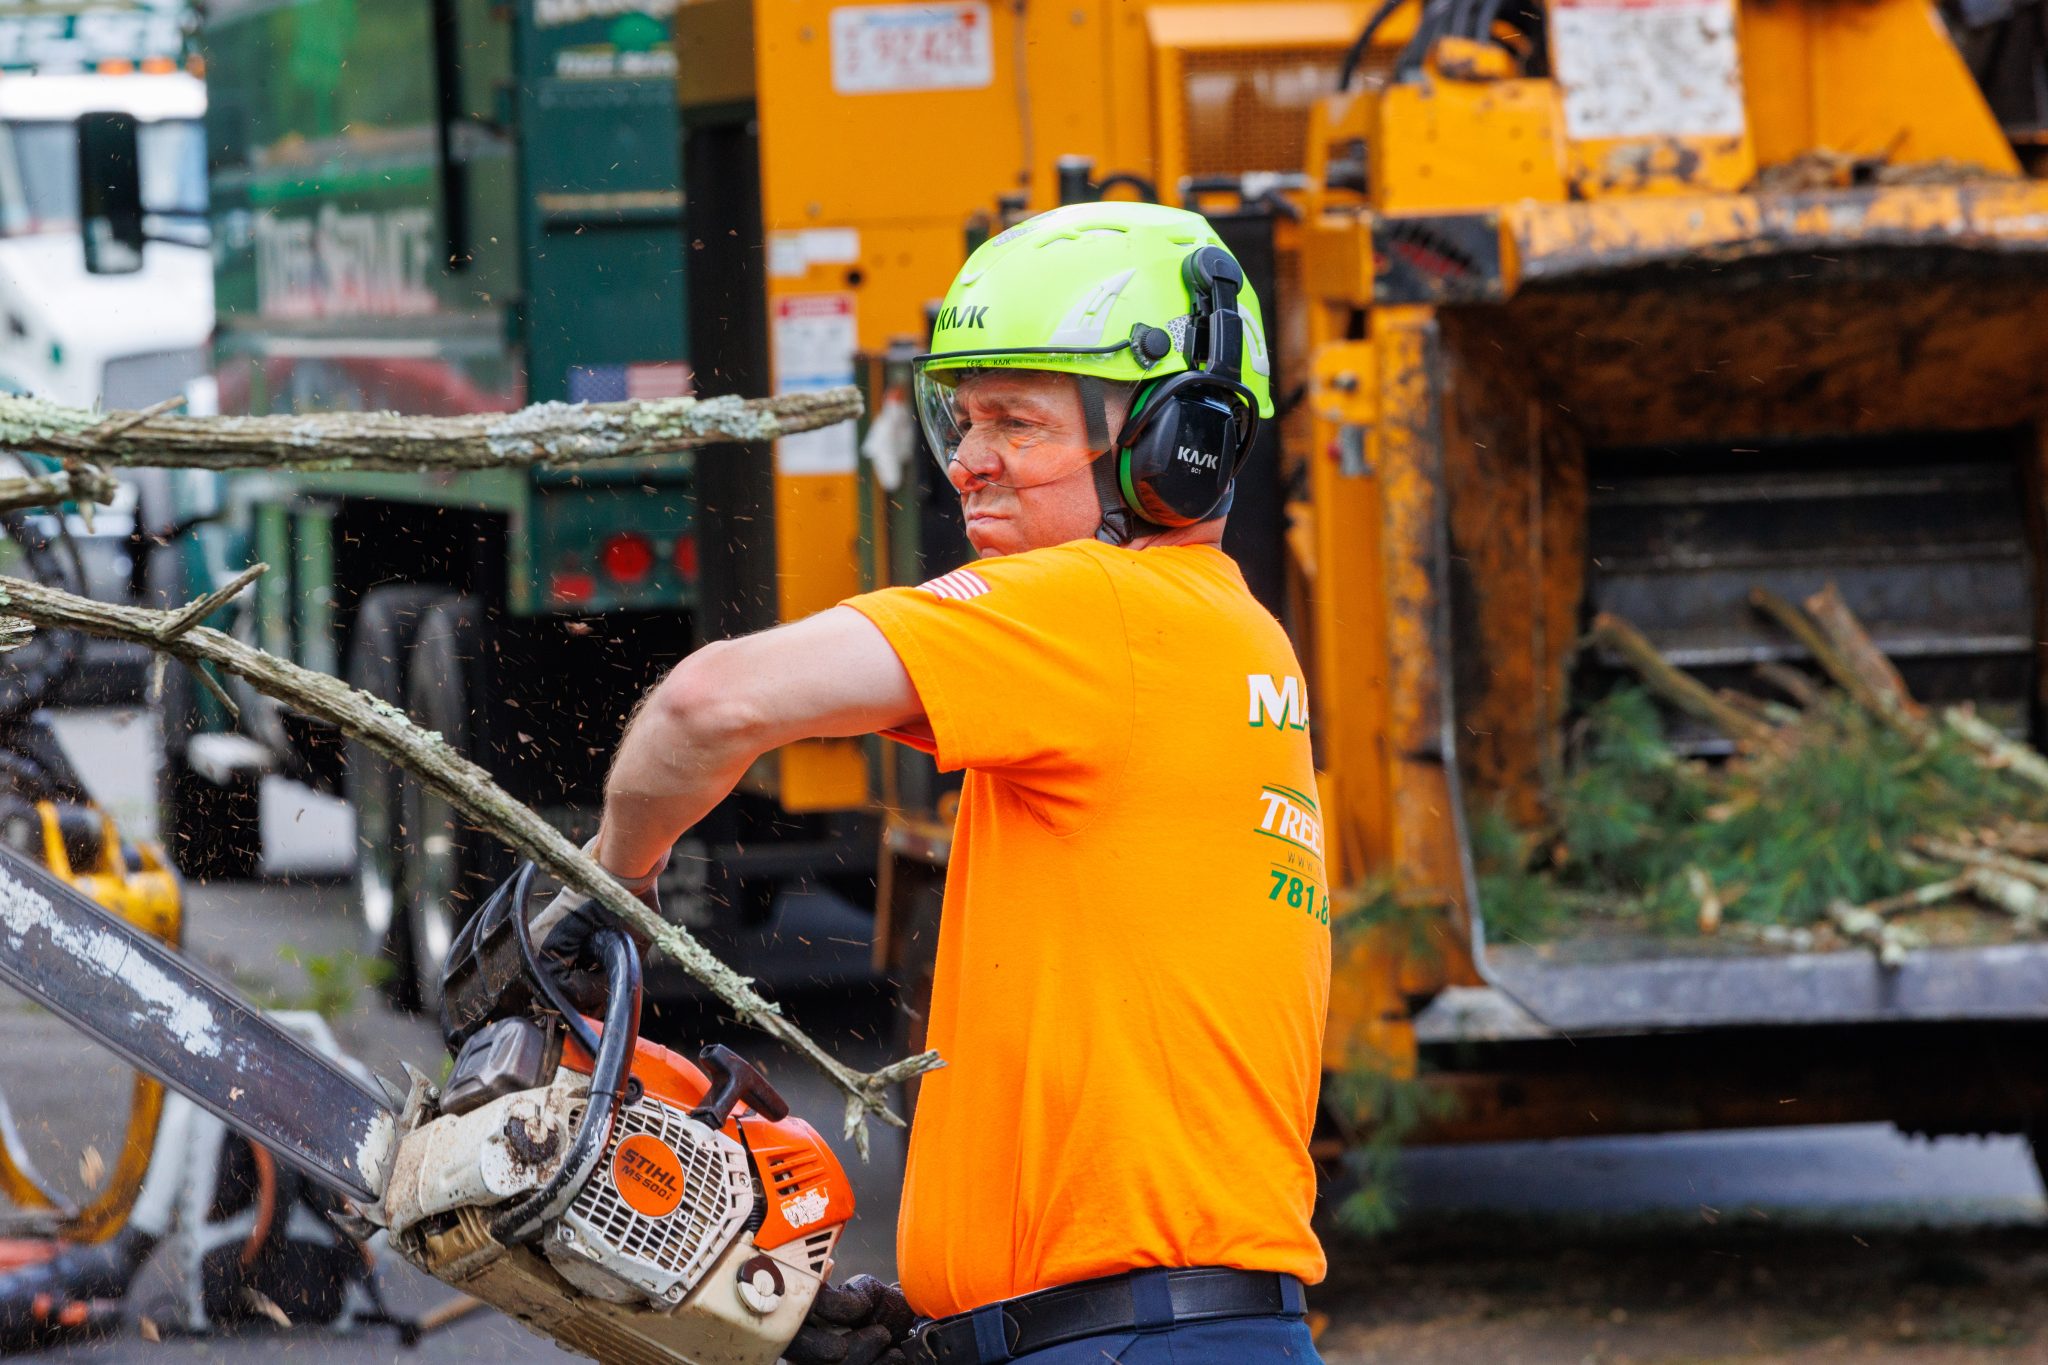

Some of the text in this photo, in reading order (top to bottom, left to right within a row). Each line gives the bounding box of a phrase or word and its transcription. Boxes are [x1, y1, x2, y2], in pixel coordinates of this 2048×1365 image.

[937, 306, 989, 332] KASK
[1177, 446, 1218, 470] KASK
[1260, 791, 1321, 855] TREE
[621, 1148, 677, 1192] STIHL
[622, 1165, 672, 1201] MS 500i
